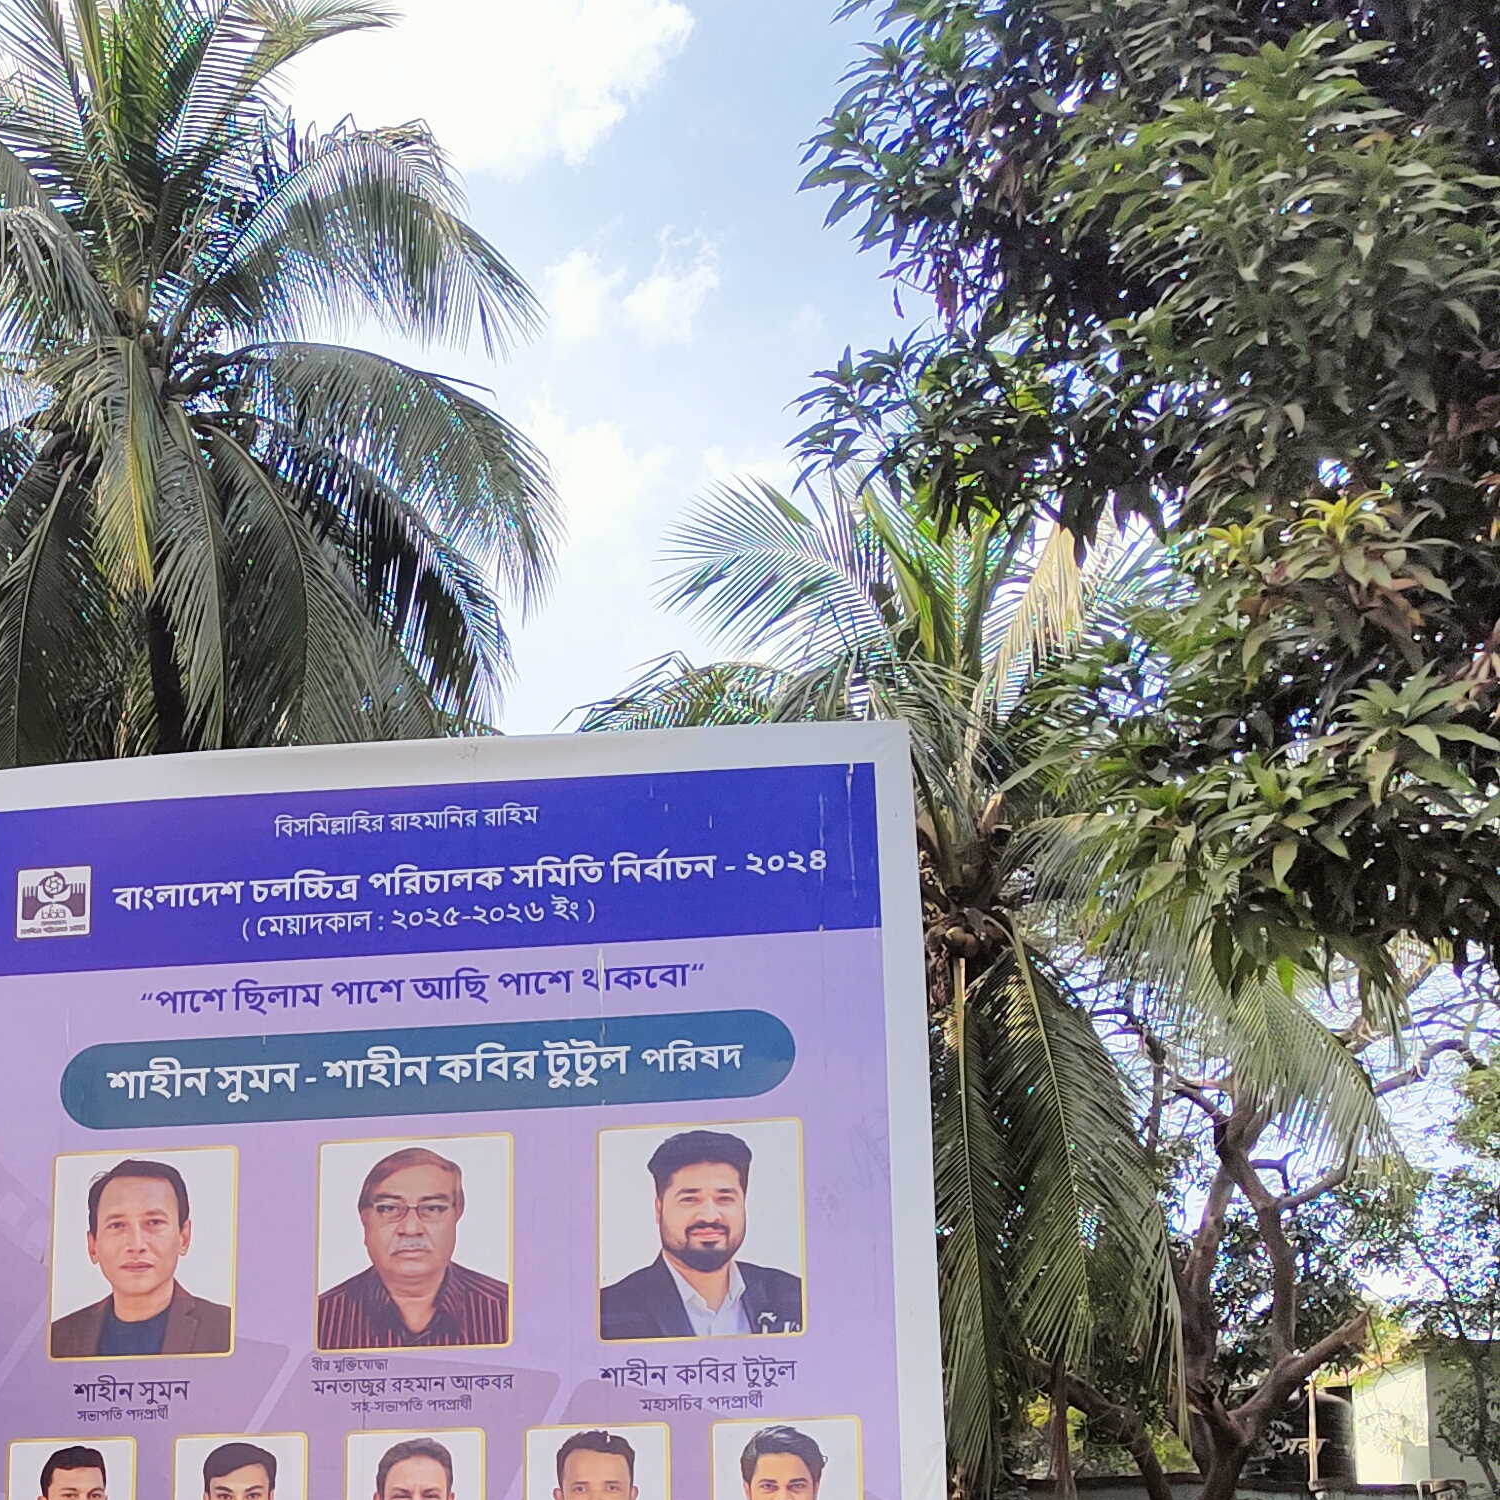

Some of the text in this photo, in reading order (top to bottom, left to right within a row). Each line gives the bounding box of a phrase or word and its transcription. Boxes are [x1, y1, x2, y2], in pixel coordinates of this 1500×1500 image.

[275, 802, 539, 838] বিসমিল্লাহির রাহমানির রাহিম
[112, 848, 827, 912] বাংলাদেশ চলচ্চিত্র পরিচালক সমিতি নির্বাচন ২০২৪
[256, 894, 579, 938] মেয়াদকাল ২০২৫-২০২৬ ইং
[231, 978, 324, 1016] ছিলাম
[330, 978, 406, 1006] পাশে
[410, 967, 490, 1003] আছি
[497, 968, 574, 997] পাশে
[106, 1038, 744, 1104] শাহীন সুমন শাহীন কবির টুটুল পরিষদ
[390, 1375, 446, 1394] রহমান
[450, 1373, 514, 1391] আকবর
[600, 1354, 797, 1389] শাহীন কবির টুটুল
[73, 1375, 190, 1406] শাহীন সুমন
[639, 1393, 703, 1413] মহাসচিব
[77, 1404, 124, 1423] সভাপতি
